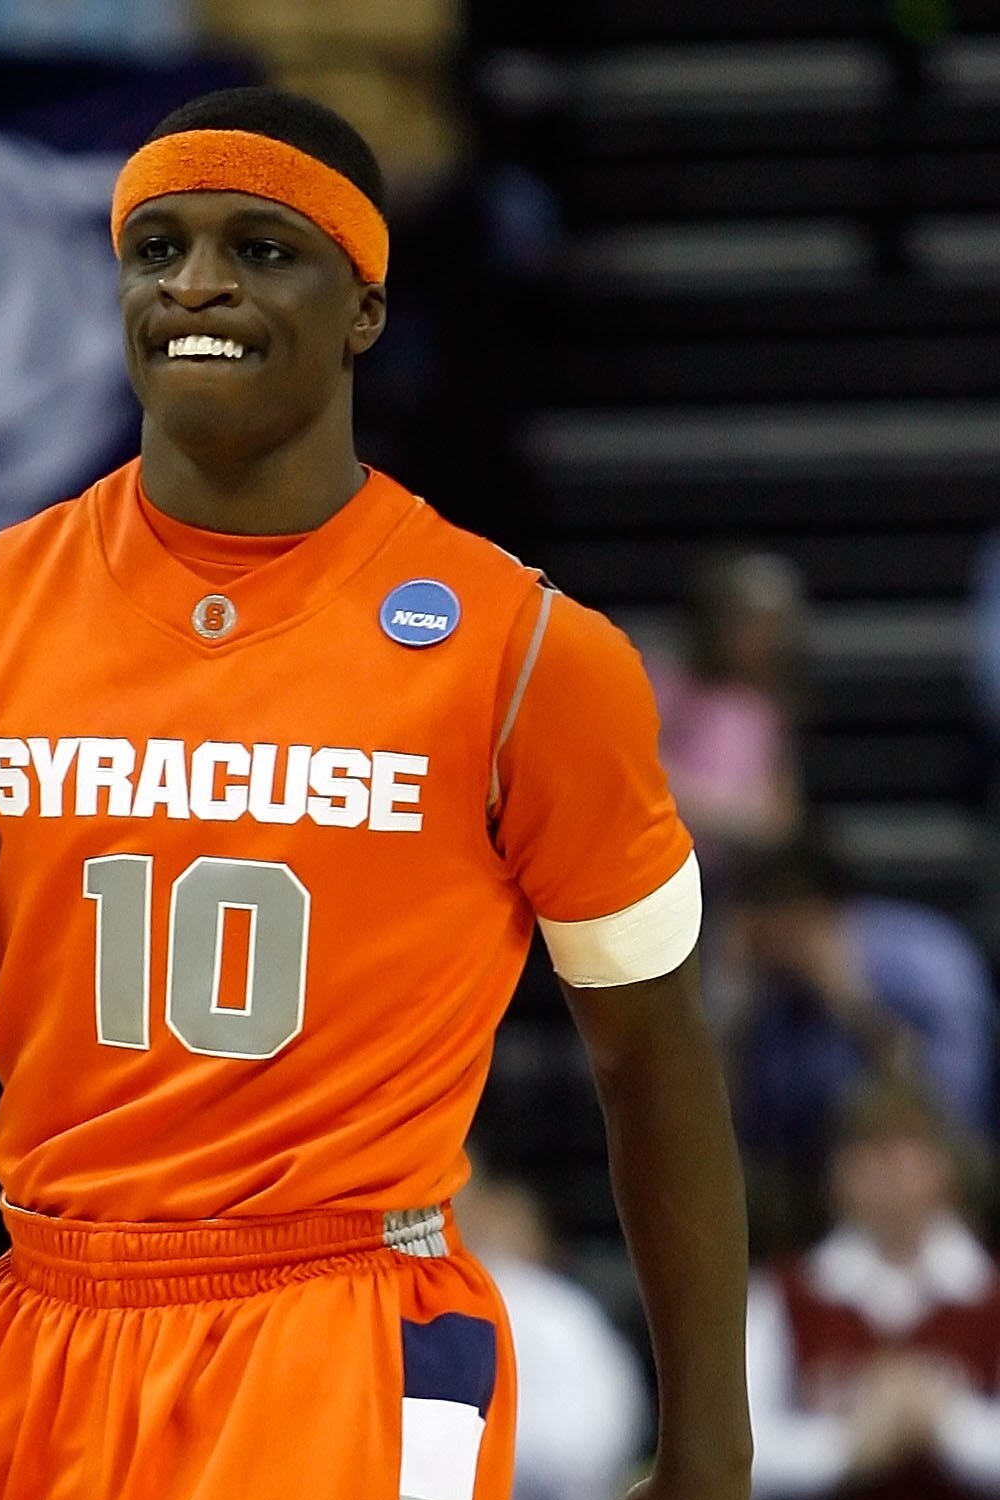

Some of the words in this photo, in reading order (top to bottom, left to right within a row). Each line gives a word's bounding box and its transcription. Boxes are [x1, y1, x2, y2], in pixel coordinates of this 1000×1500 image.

[203, 602, 225, 631] S
[391, 609, 448, 631] NCAA
[83, 853, 311, 1059] 10
